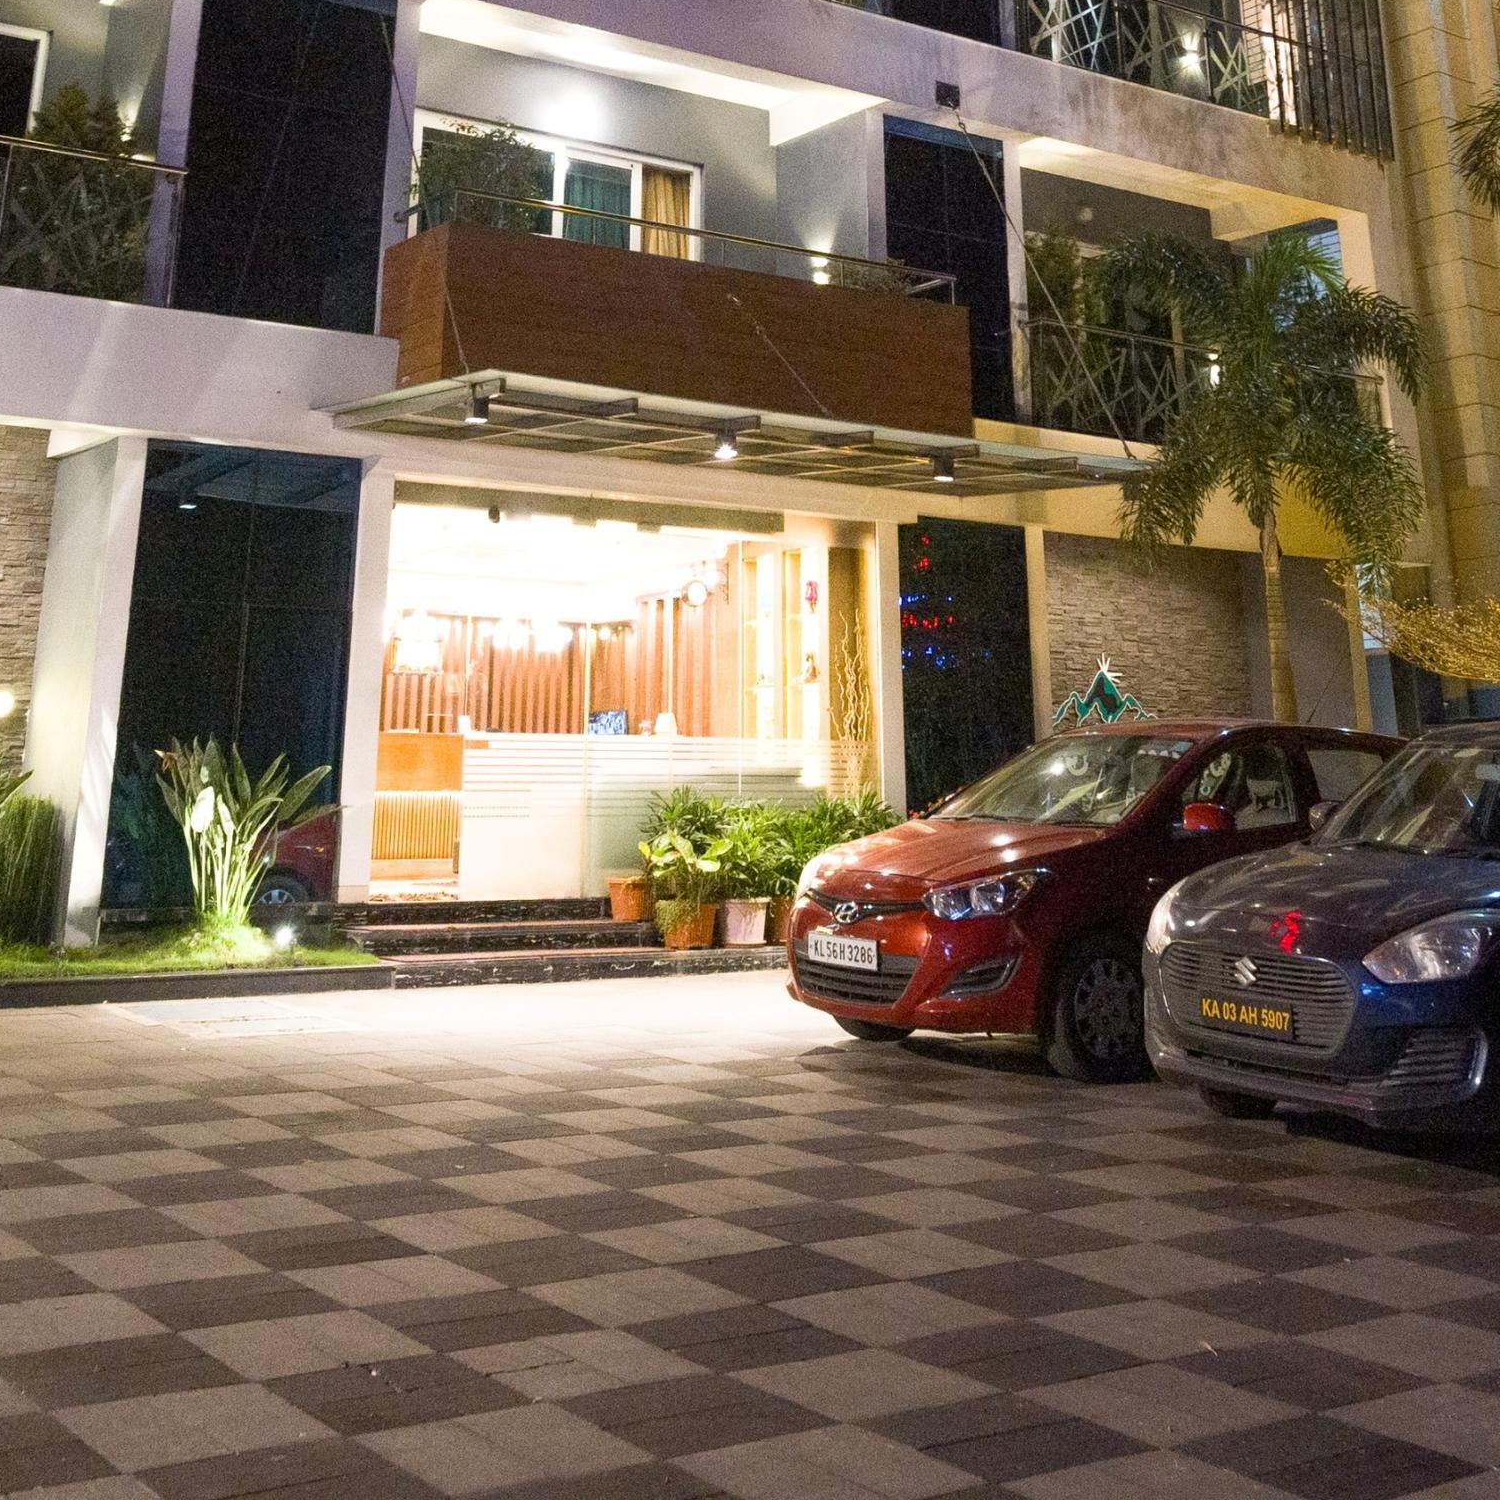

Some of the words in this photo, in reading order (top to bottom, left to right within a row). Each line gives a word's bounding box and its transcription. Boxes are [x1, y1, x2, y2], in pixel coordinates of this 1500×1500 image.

[1202, 998, 1220, 1019] KA
[1223, 1001, 1237, 1021] 03
[1240, 1005, 1258, 1025] AH
[1261, 1008, 1290, 1031] 5907
